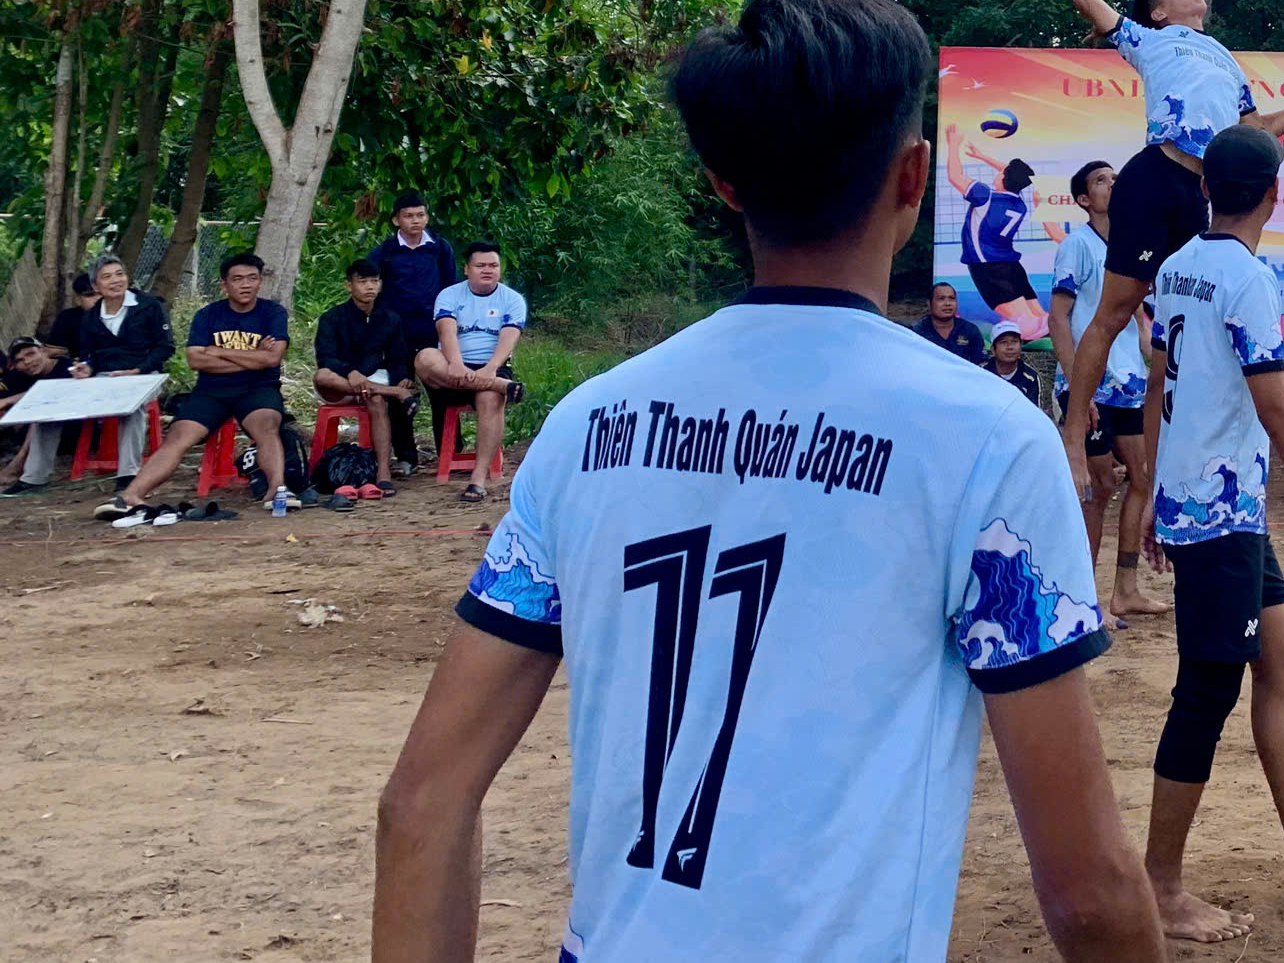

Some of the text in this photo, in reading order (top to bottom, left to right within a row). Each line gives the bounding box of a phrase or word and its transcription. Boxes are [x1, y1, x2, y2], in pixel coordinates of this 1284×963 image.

[1047, 194, 1078, 206] CH
[1000, 209, 1022, 237] 7
[220, 330, 262, 348] WANT
[581, 399, 893, 496] Thiên Thanh Quán Japan
